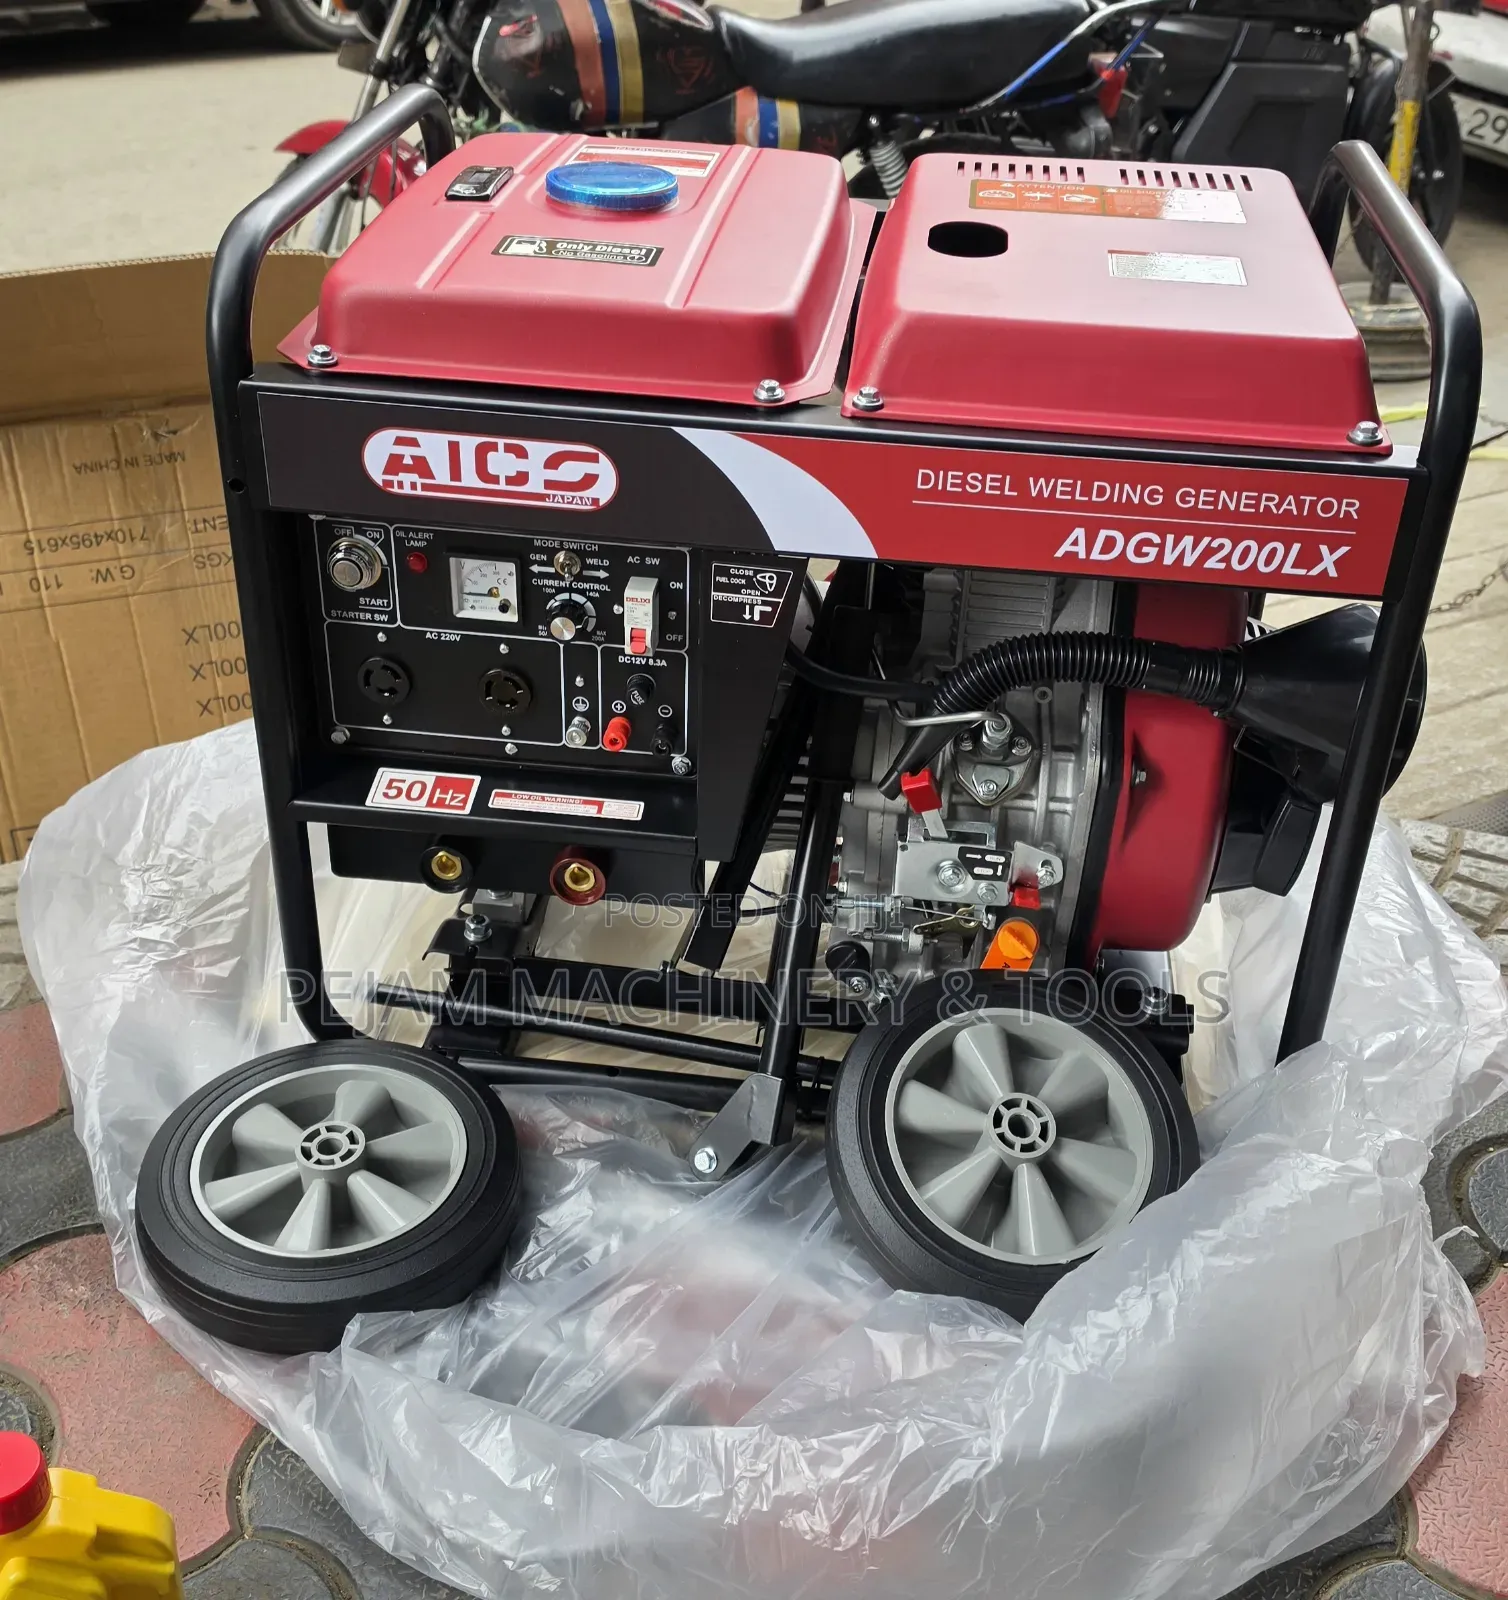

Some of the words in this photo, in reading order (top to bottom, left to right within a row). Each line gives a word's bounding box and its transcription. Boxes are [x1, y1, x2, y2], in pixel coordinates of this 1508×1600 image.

[1016, 183, 1085, 191] ATTENTION
[556, 242, 593, 251] Only
[596, 244, 647, 256] Diesel
[577, 251, 625, 260] Gasoline
[72, 459, 121, 475] CHINA
[124, 455, 140, 469] IN
[916, 469, 1018, 497] DIESEL
[1029, 476, 1163, 506] WELDING
[1175, 487, 1360, 519] GENERATOR
[546, 493, 593, 506] JAPAN
[334, 528, 352, 536] OFF
[366, 530, 380, 539] ON
[395, 530, 408, 538] OIL
[408, 531, 434, 540] ALERT
[24, 526, 148, 555] 710x495x615
[405, 539, 427, 548] LAMP
[534, 539, 560, 549] MODE
[563, 541, 599, 551] SWITCH
[1054, 527, 1352, 578] ADGW200LX
[530, 553, 547, 561] GEN
[586, 558, 610, 566] WELD
[627, 556, 640, 564] AC
[645, 557, 660, 565] SW
[730, 568, 754, 576] CLOSE
[29, 574, 63, 593] 110
[532, 578, 570, 588] CURRENT
[572, 582, 611, 592] CONTROL
[670, 582, 683, 590] ON
[741, 588, 761, 596] OPEN
[359, 597, 389, 607] START
[714, 595, 762, 605] DECOMPRESS
[331, 610, 372, 621] STARTER
[374, 613, 389, 622] SW
[426, 632, 439, 640] AC
[440, 632, 461, 641] 220V
[666, 634, 684, 642] OFF
[618, 656, 647, 665] DC12V
[648, 658, 668, 667] 8.3A
[632, 690, 645, 705] FUSE
[382, 778, 428, 801] 50
[544, 796, 584, 805] WARNING!
